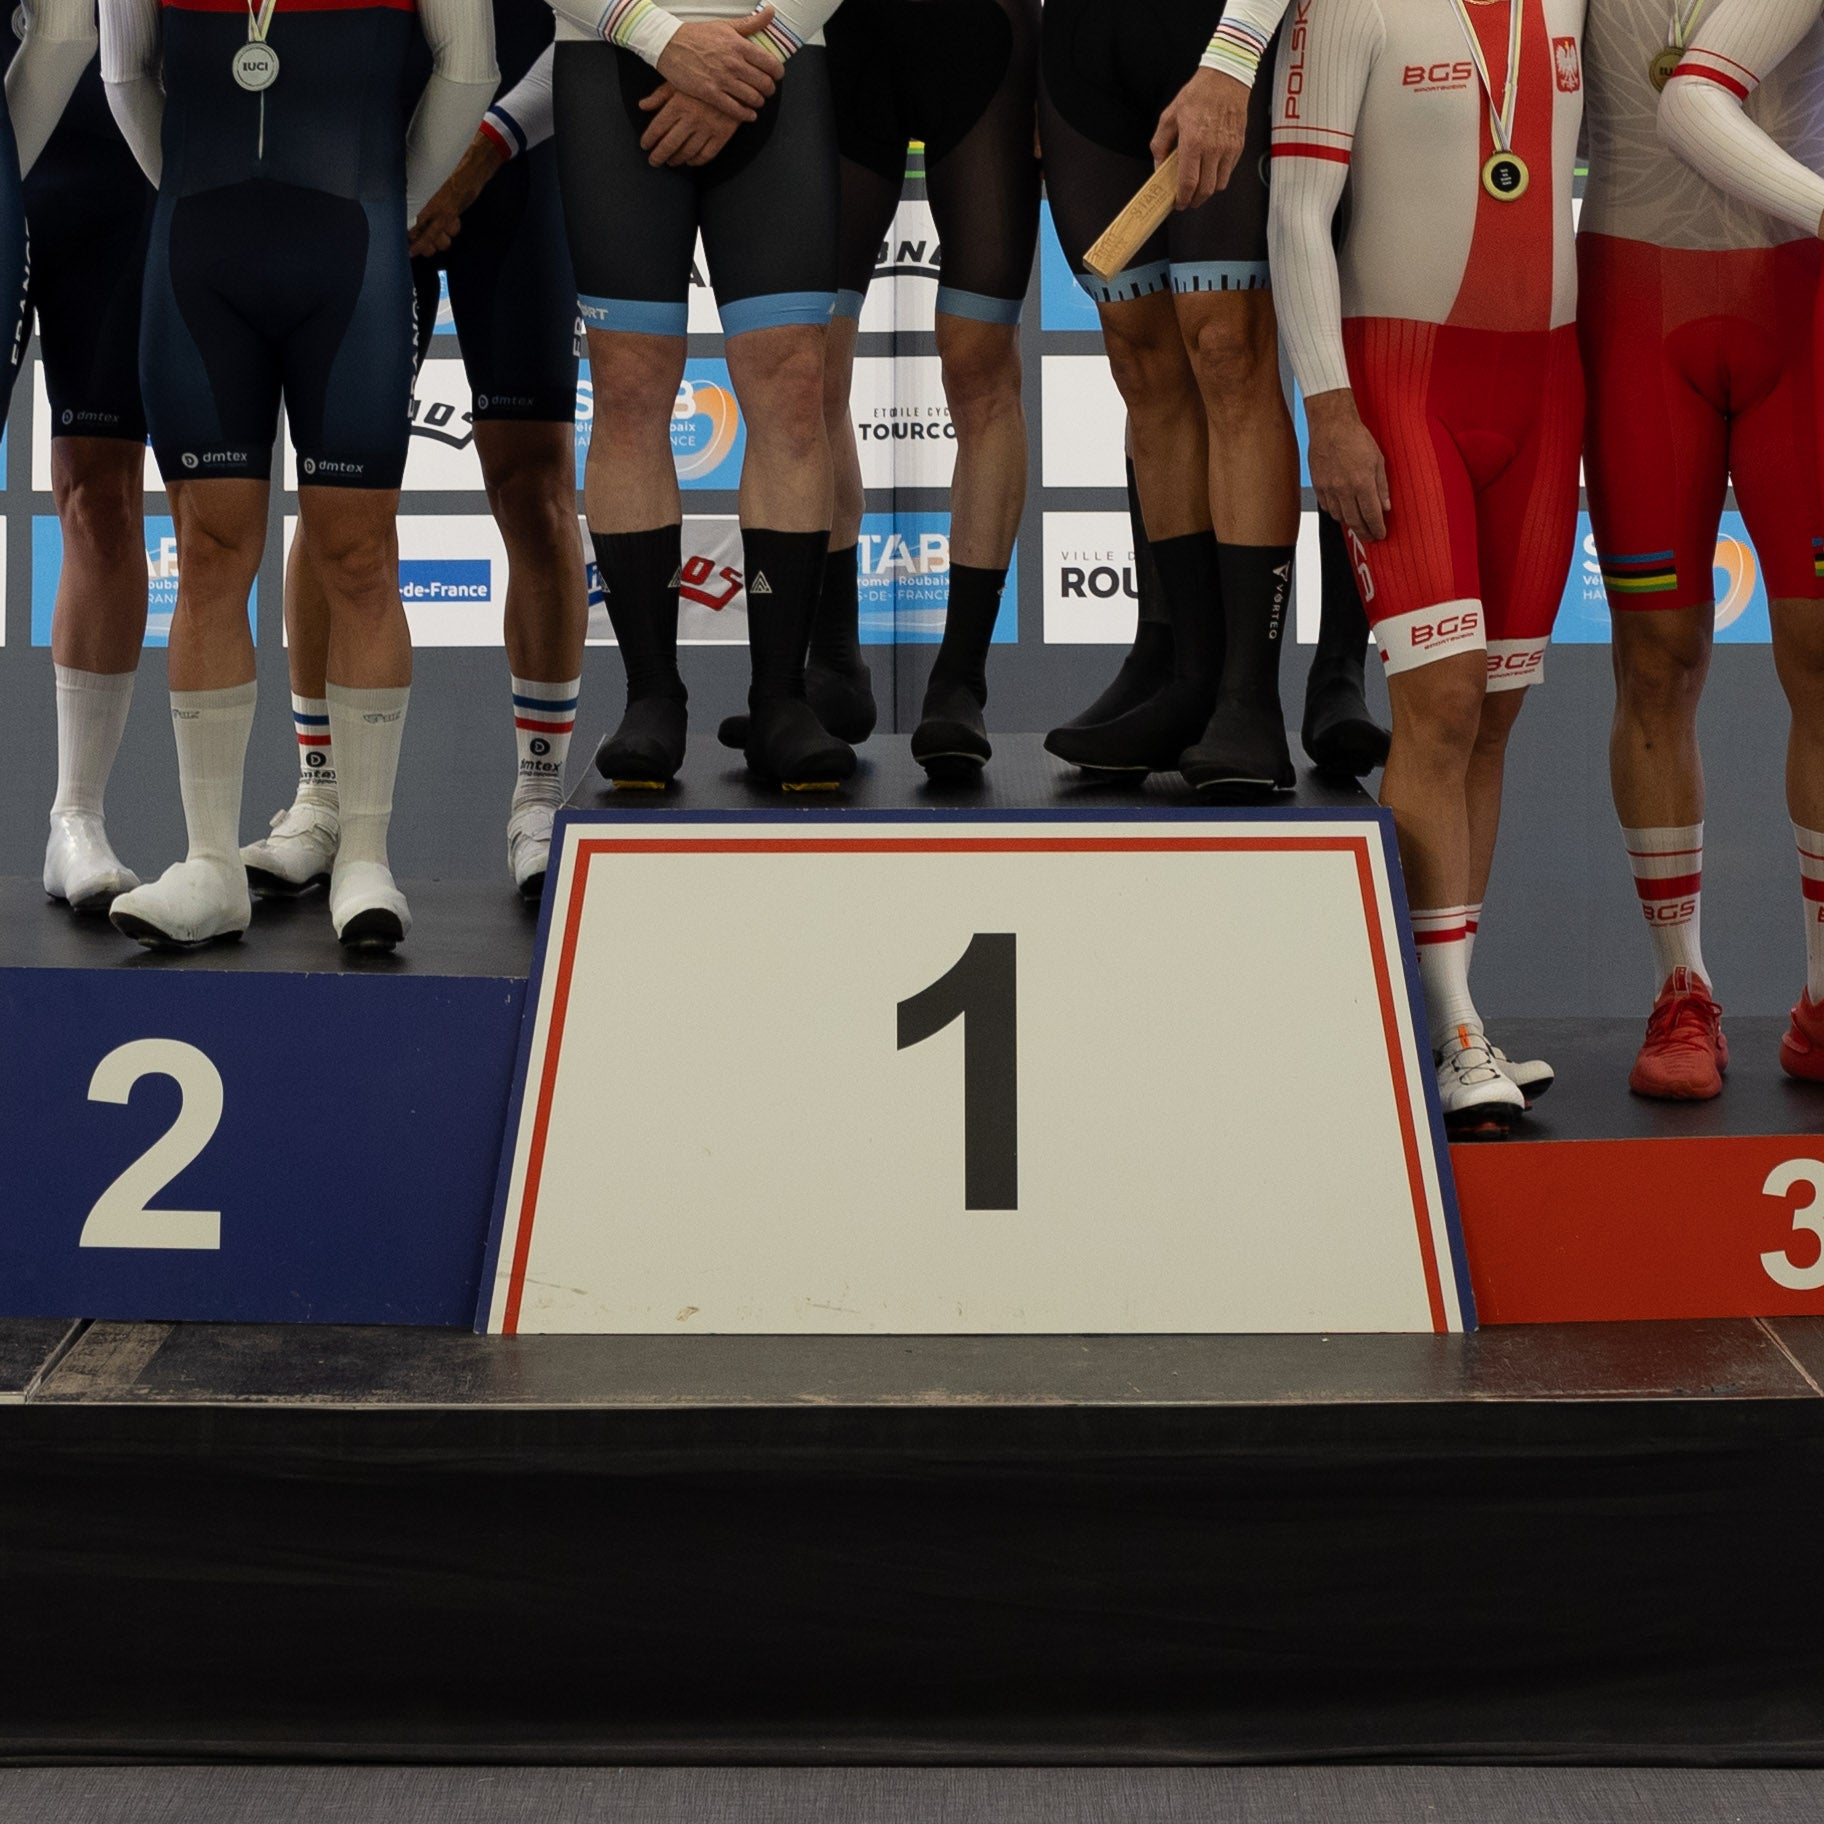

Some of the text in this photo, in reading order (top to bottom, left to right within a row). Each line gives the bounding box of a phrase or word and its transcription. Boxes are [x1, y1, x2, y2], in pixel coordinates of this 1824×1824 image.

[1403, 61, 1473, 87] BGS
[203, 451, 247, 463] dmtex
[319, 460, 364, 474] dmtex
[1061, 550, 1122, 561] VILLE
[1411, 612, 1478, 646] BGS
[897, 932, 1019, 1212] 1
[79, 1038, 224, 1250] 2
